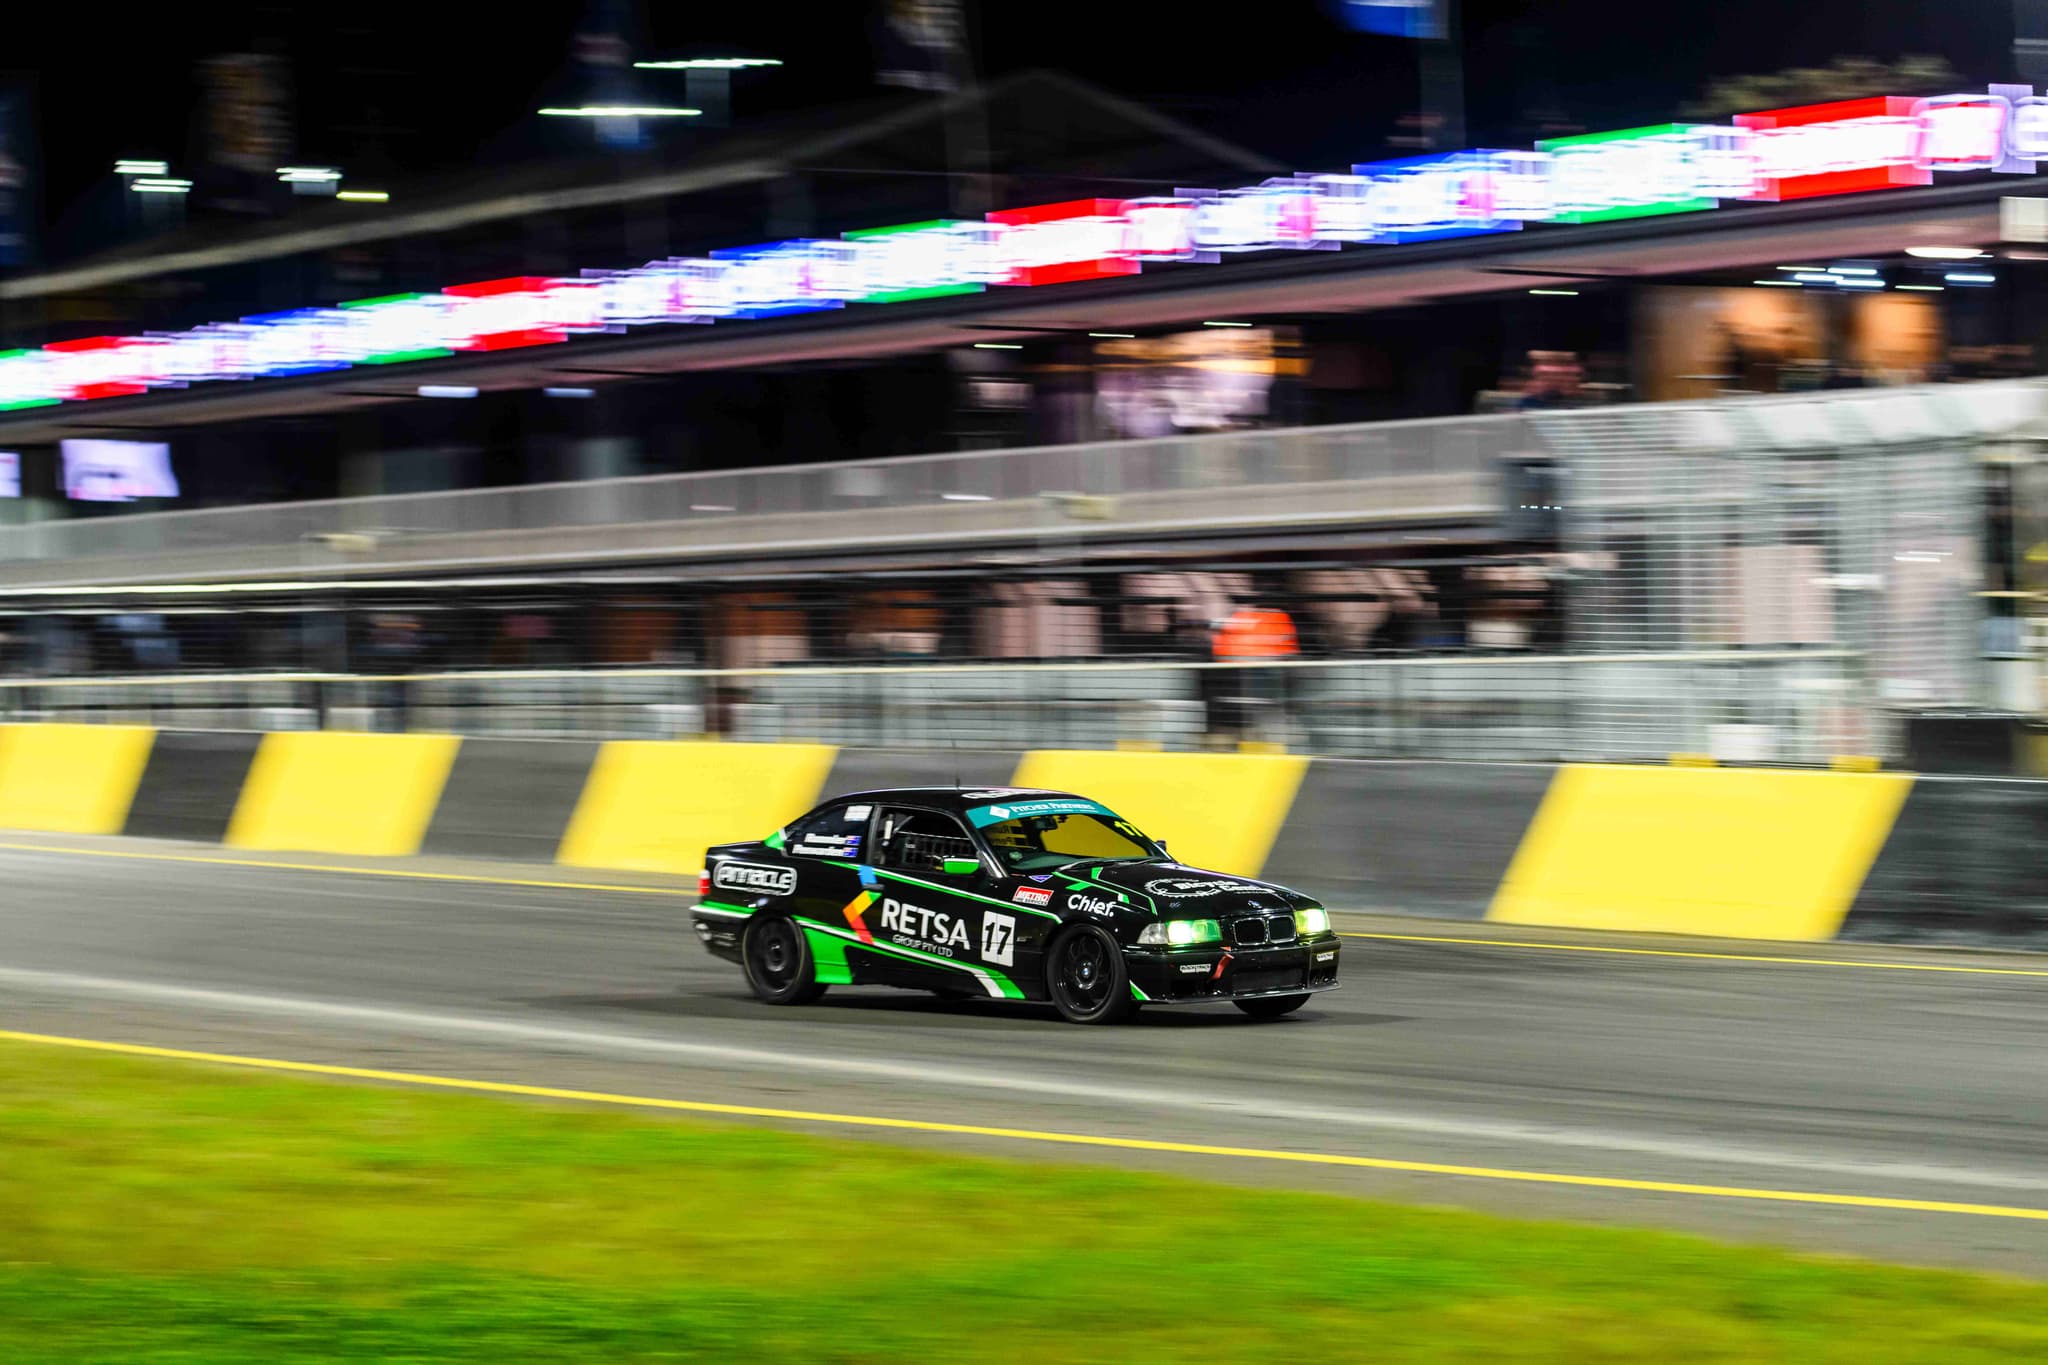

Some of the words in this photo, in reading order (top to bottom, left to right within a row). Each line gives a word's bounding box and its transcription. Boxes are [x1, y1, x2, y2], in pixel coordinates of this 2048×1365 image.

[1114, 821, 1144, 837] 17
[881, 898, 971, 950] RETSA
[984, 921, 1013, 956] 17
[892, 934, 921, 949] GROUP
[921, 941, 938, 953] PTY
[937, 946, 954, 957] LTD
